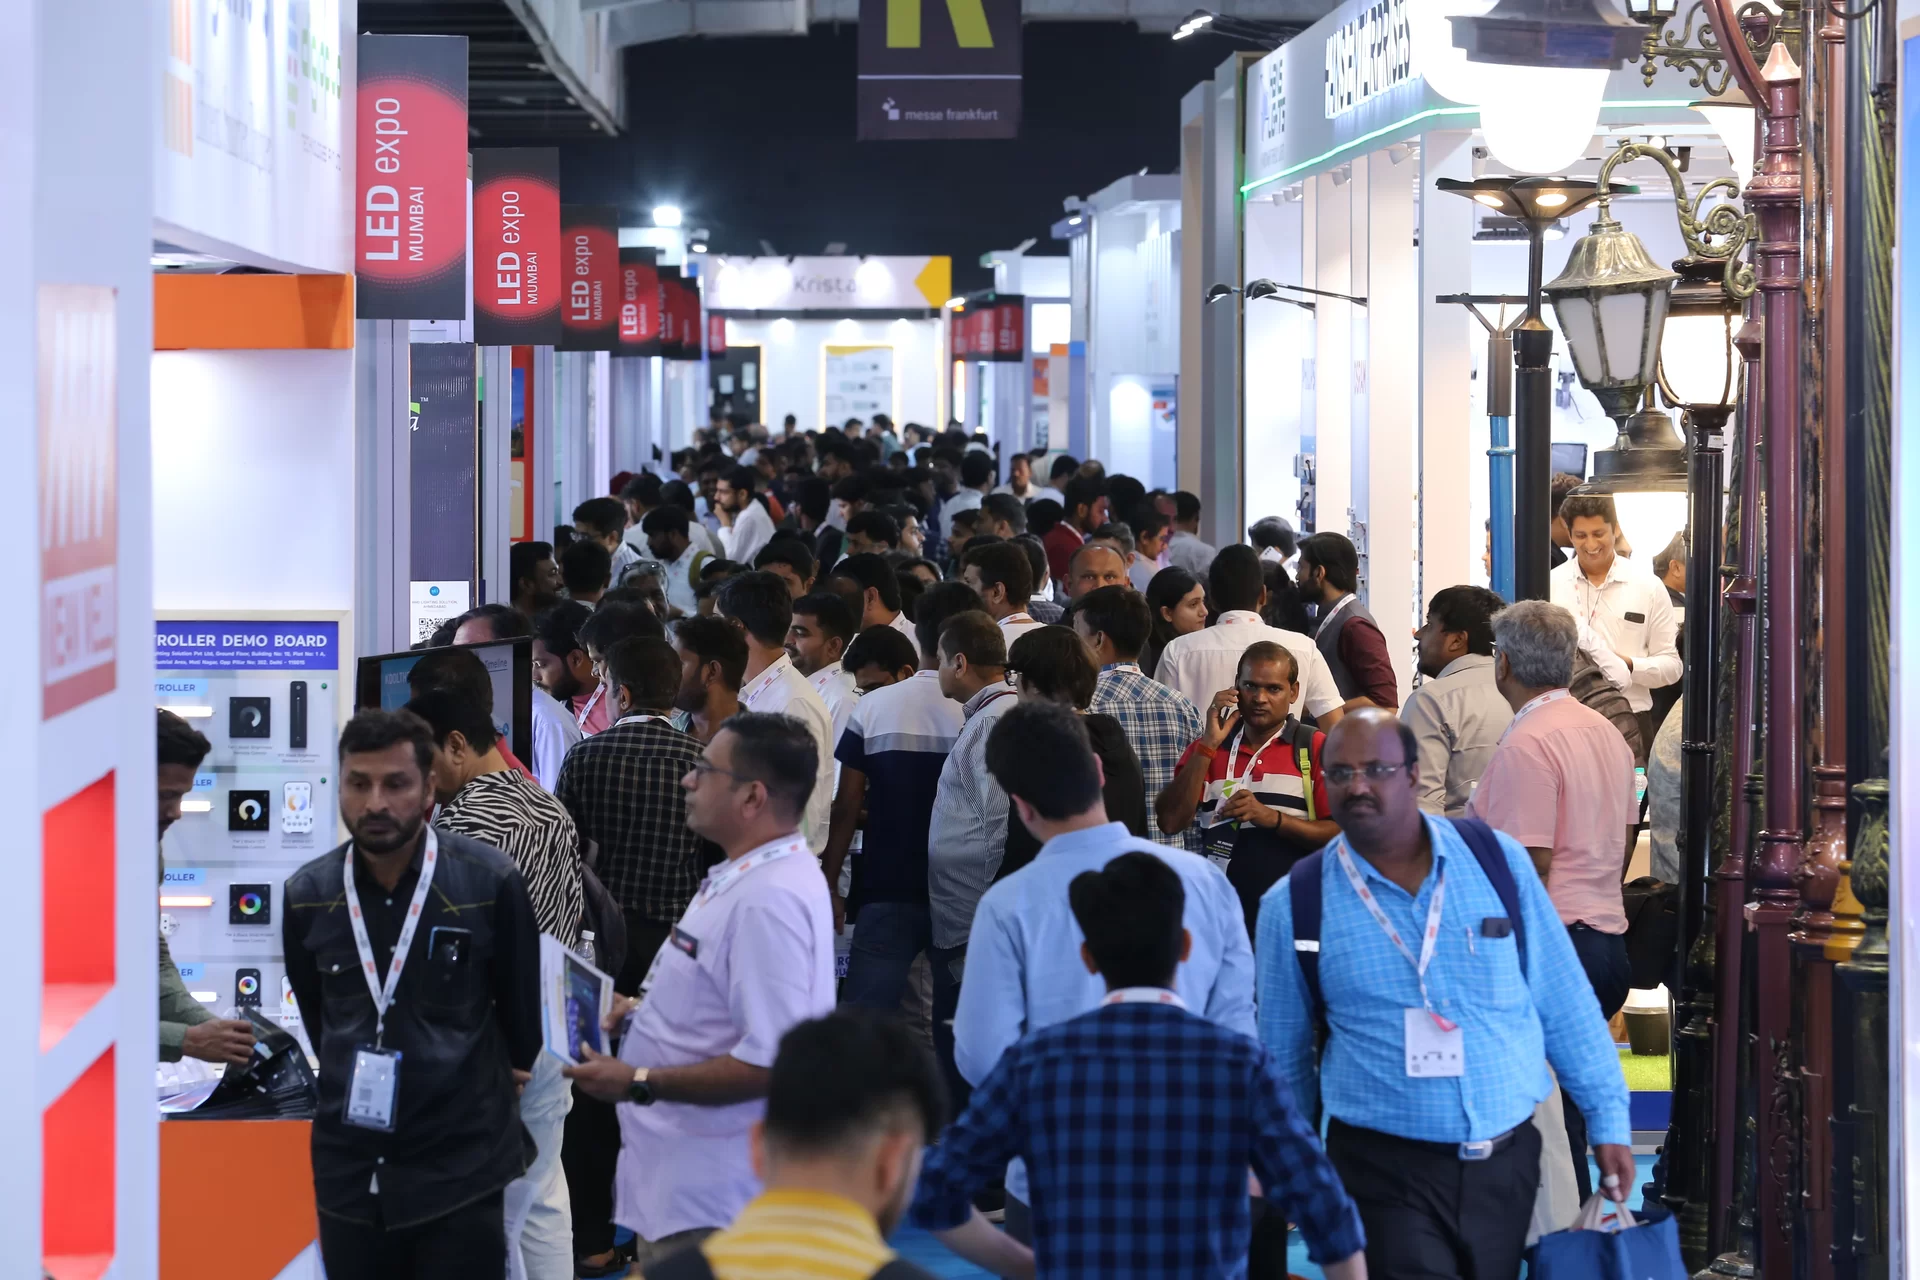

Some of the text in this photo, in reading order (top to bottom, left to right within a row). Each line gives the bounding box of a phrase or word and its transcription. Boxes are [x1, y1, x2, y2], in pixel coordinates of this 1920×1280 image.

[905, 108, 998, 121] messe frankfurt
[365, 97, 408, 261] LED expo
[409, 186, 424, 261] MUMBAI
[497, 191, 525, 305] LED expo
[527, 252, 538, 305] MUMBAI
[571, 235, 593, 321] LED expo
[594, 280, 602, 321] MUMBAI
[622, 269, 638, 336] LED expo
[222, 634, 268, 647] DEMO
[274, 635, 328, 647] BOARD
[181, 968, 193, 976] ER
